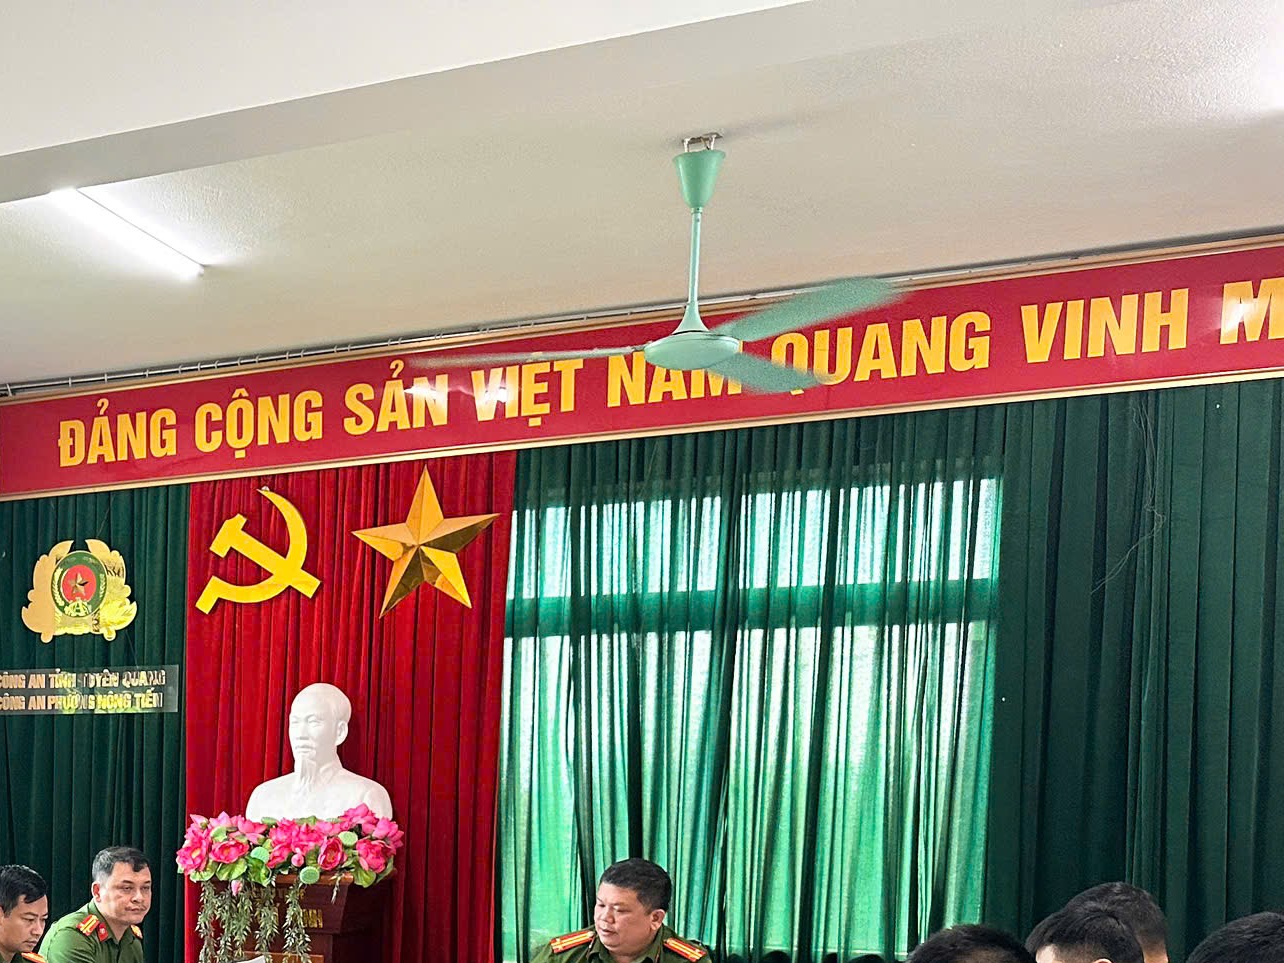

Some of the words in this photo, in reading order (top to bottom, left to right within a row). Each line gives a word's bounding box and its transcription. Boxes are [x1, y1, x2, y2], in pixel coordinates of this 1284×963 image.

[58, 398, 177, 467] ĐẢNG
[195, 388, 323, 459] CỘNG
[344, 359, 448, 436] SẢN
[471, 353, 584, 427] VIỆT
[771, 311, 991, 396] QUANG
[1021, 288, 1189, 364] VINH
[28, 673, 45, 689] AN
[122, 669, 166, 688] QUANG
[28, 695, 45, 710] AN
[96, 690, 132, 710] NÔNG
